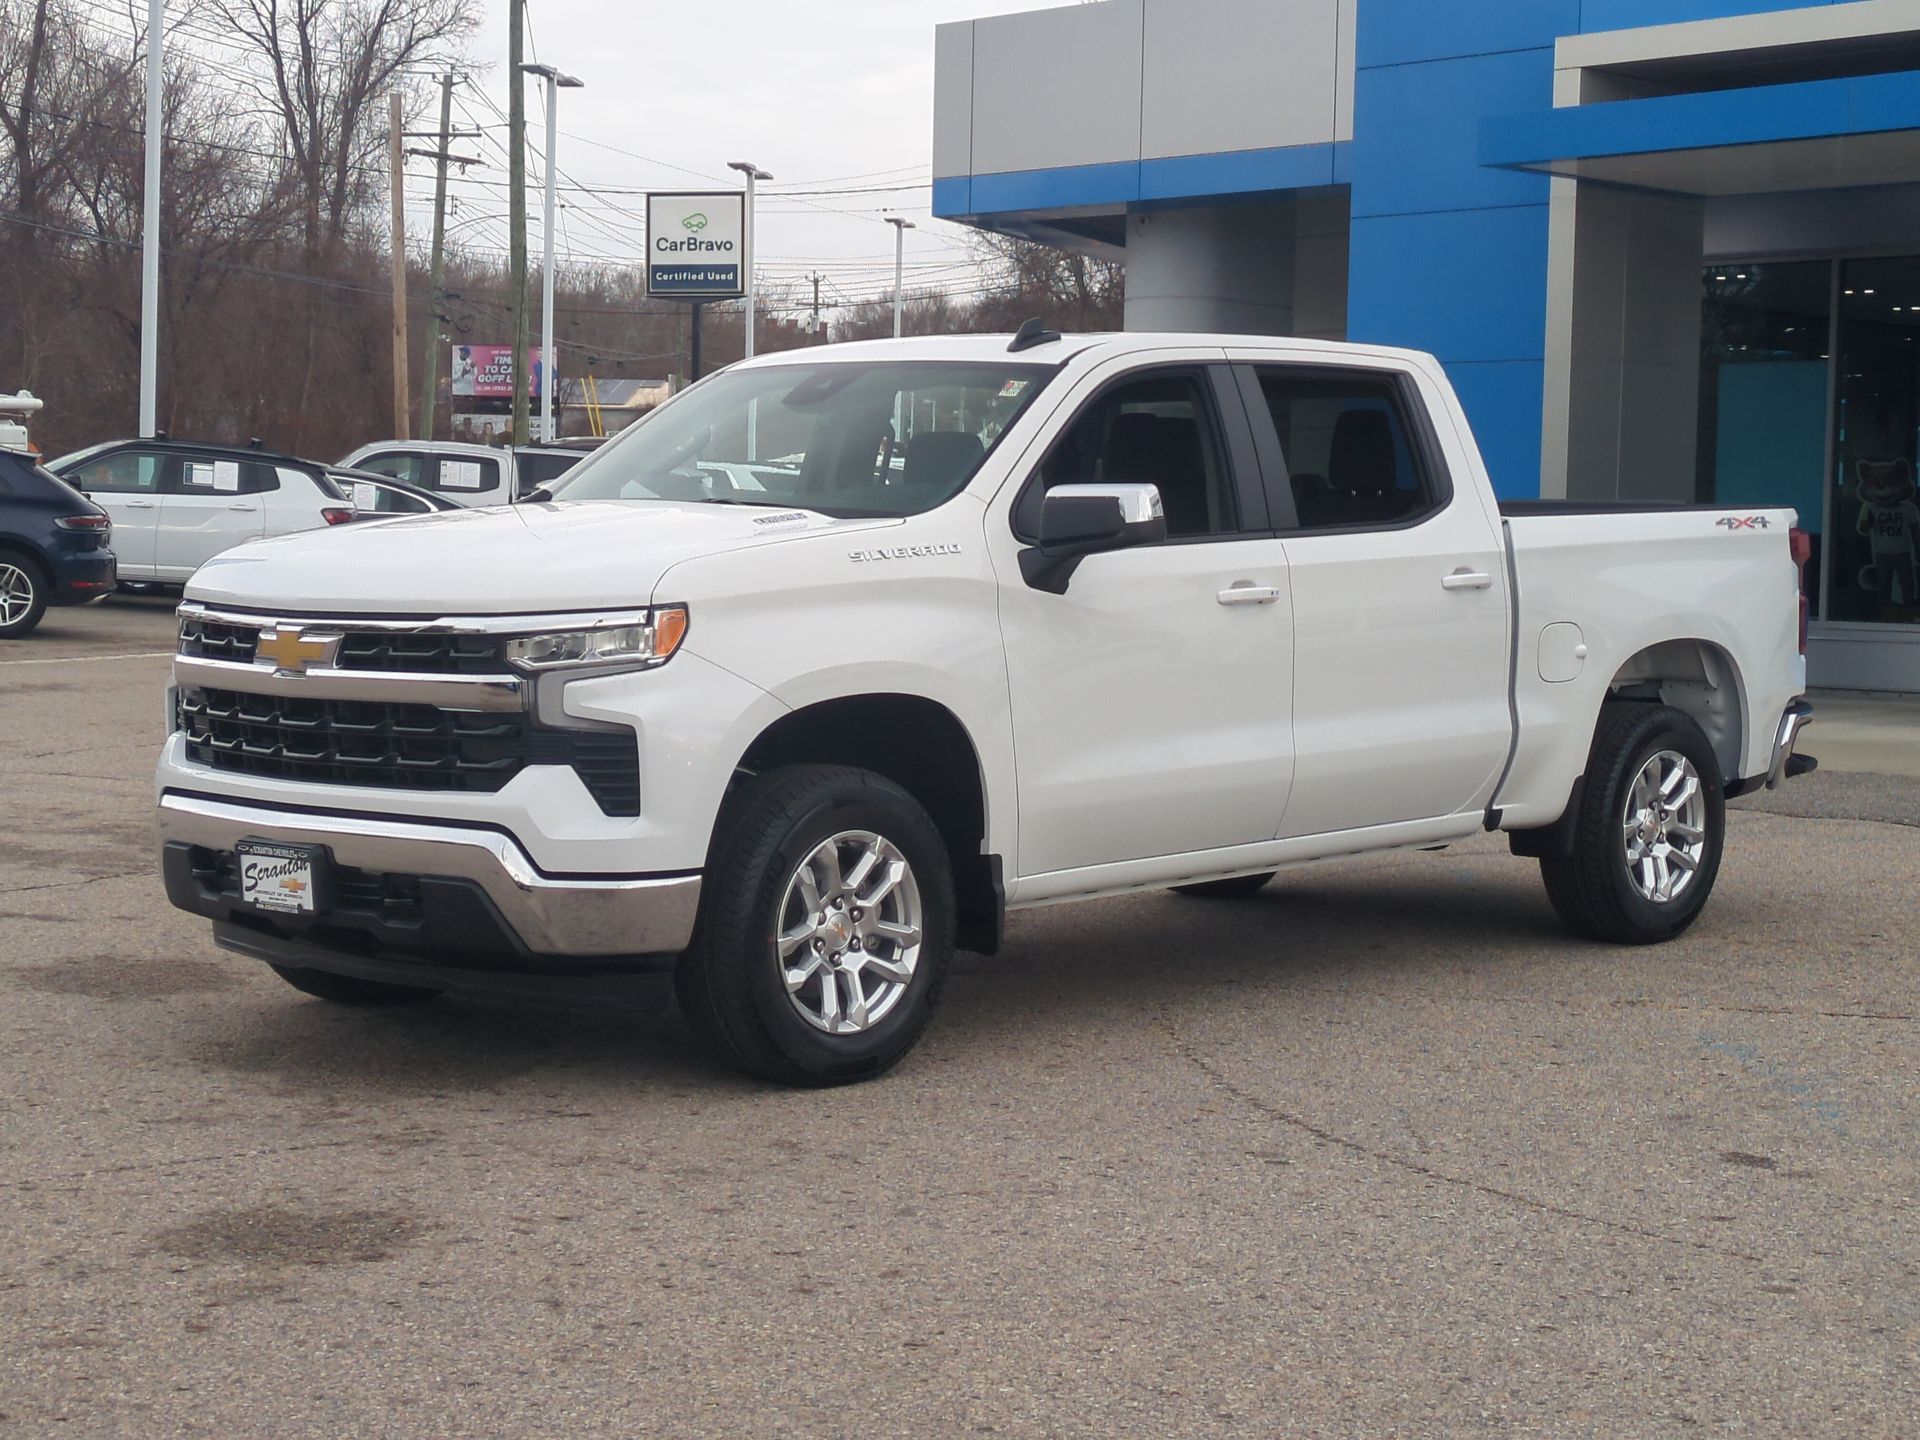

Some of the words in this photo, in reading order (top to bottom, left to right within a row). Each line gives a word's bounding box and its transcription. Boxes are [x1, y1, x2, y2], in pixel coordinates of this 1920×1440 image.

[656, 237, 734, 252] CarBravo
[655, 271, 704, 281] Certified
[707, 271, 734, 281] Used
[484, 365, 499, 374] TO
[477, 374, 505, 383] GOFF
[1877, 512, 1904, 525] CAR
[1879, 525, 1904, 538] FOX
[848, 543, 962, 562] SILVERADO
[244, 858, 309, 892] Scranton
